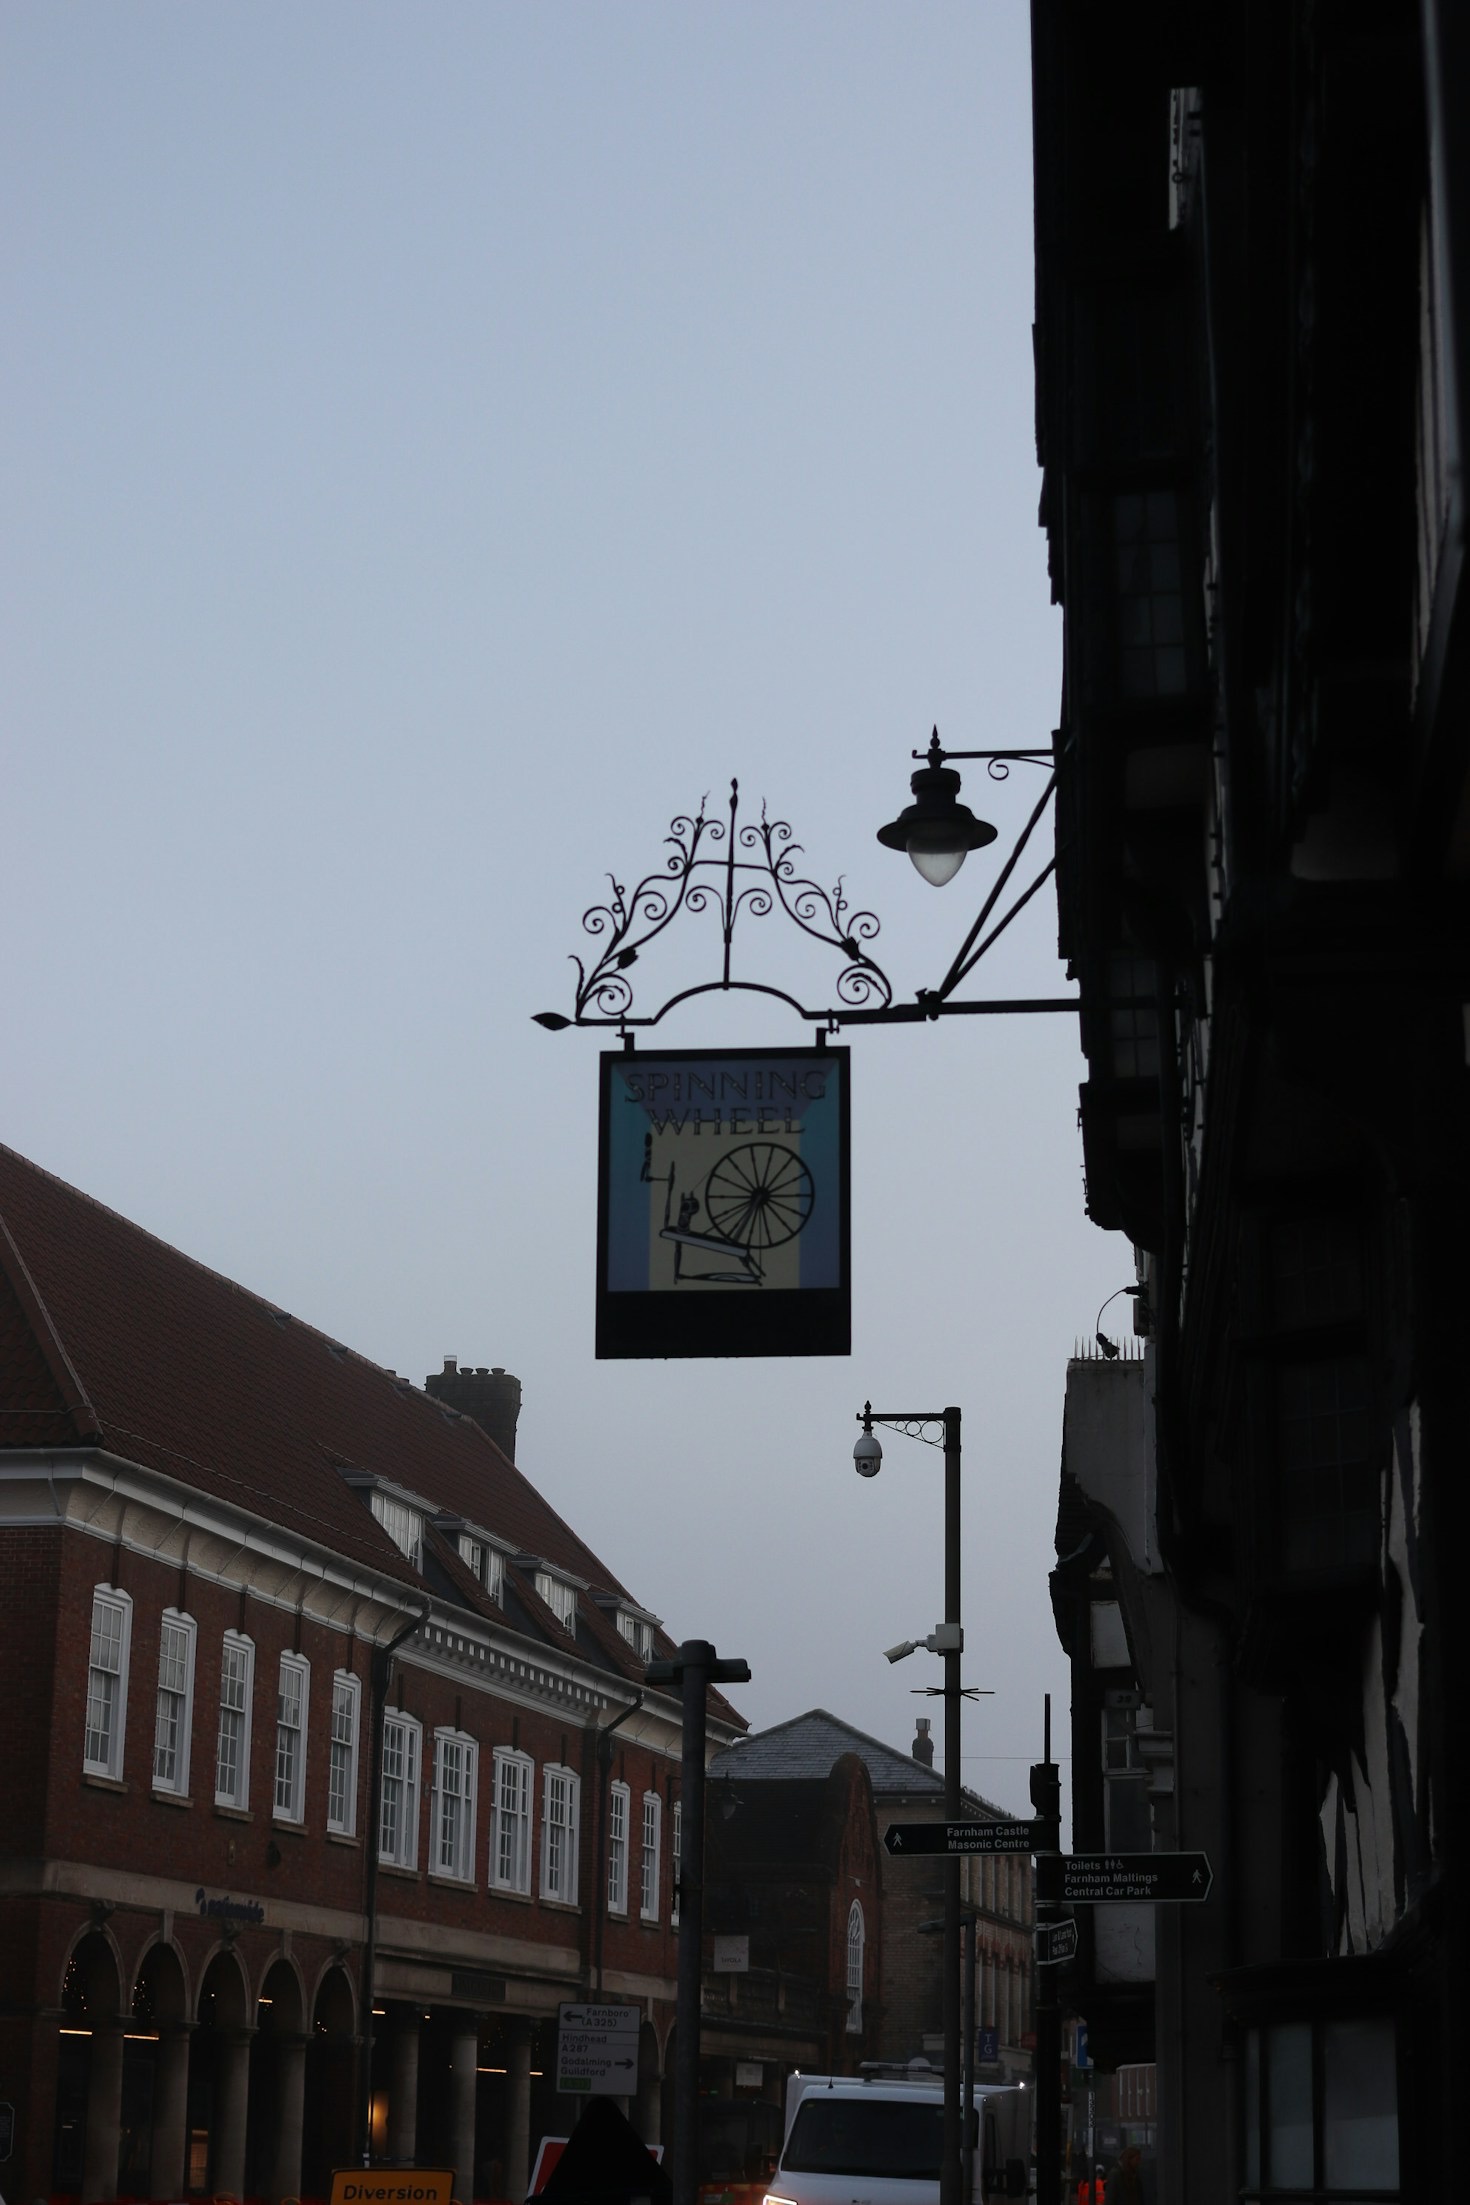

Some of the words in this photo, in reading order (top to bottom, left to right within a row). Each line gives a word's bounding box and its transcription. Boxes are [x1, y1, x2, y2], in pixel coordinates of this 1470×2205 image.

[625, 1070, 826, 1103] SPINNING
[646, 1106, 806, 1136] WHEEL
[946, 1827, 993, 1837] Farnham
[995, 1826, 1030, 1836] Castle
[947, 1839, 992, 1850] Masonic
[994, 1838, 1030, 1848] Centre
[1064, 1861, 1101, 1871] Toilets
[1064, 1873, 1110, 1884] Farnham
[1112, 1872, 1159, 1884] Maltings
[1064, 1886, 1104, 1897] Central
[1105, 1886, 1125, 1896] Car
[1126, 1885, 1152, 1895] Park
[562, 2033, 607, 2043] Hindhead
[560, 2056, 612, 2068] Godalming
[560, 2067, 606, 2076] Guildford
[343, 2185, 437, 2200] Diversion
